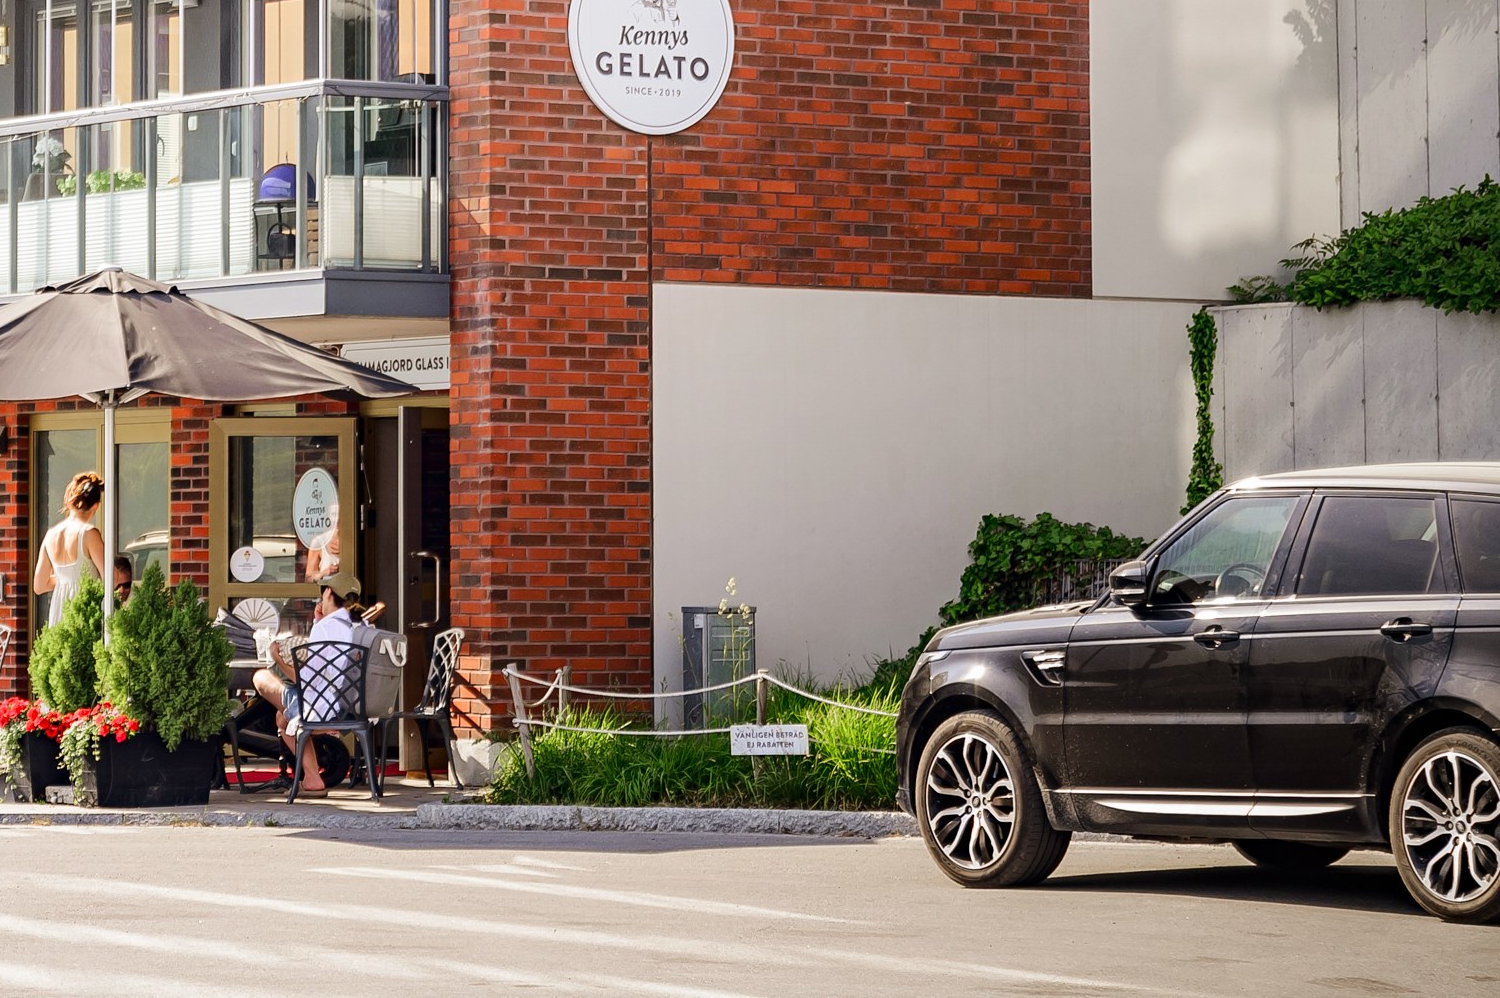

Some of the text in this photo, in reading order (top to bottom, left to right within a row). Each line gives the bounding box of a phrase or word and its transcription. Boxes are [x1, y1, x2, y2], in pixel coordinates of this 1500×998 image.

[618, 25, 689, 50] Kennys
[595, 51, 709, 81] GELATO
[415, 357, 444, 371] GLASS
[299, 517, 332, 528] GELATO
[734, 730, 804, 739] VÄNLIGEN BETRÄD
